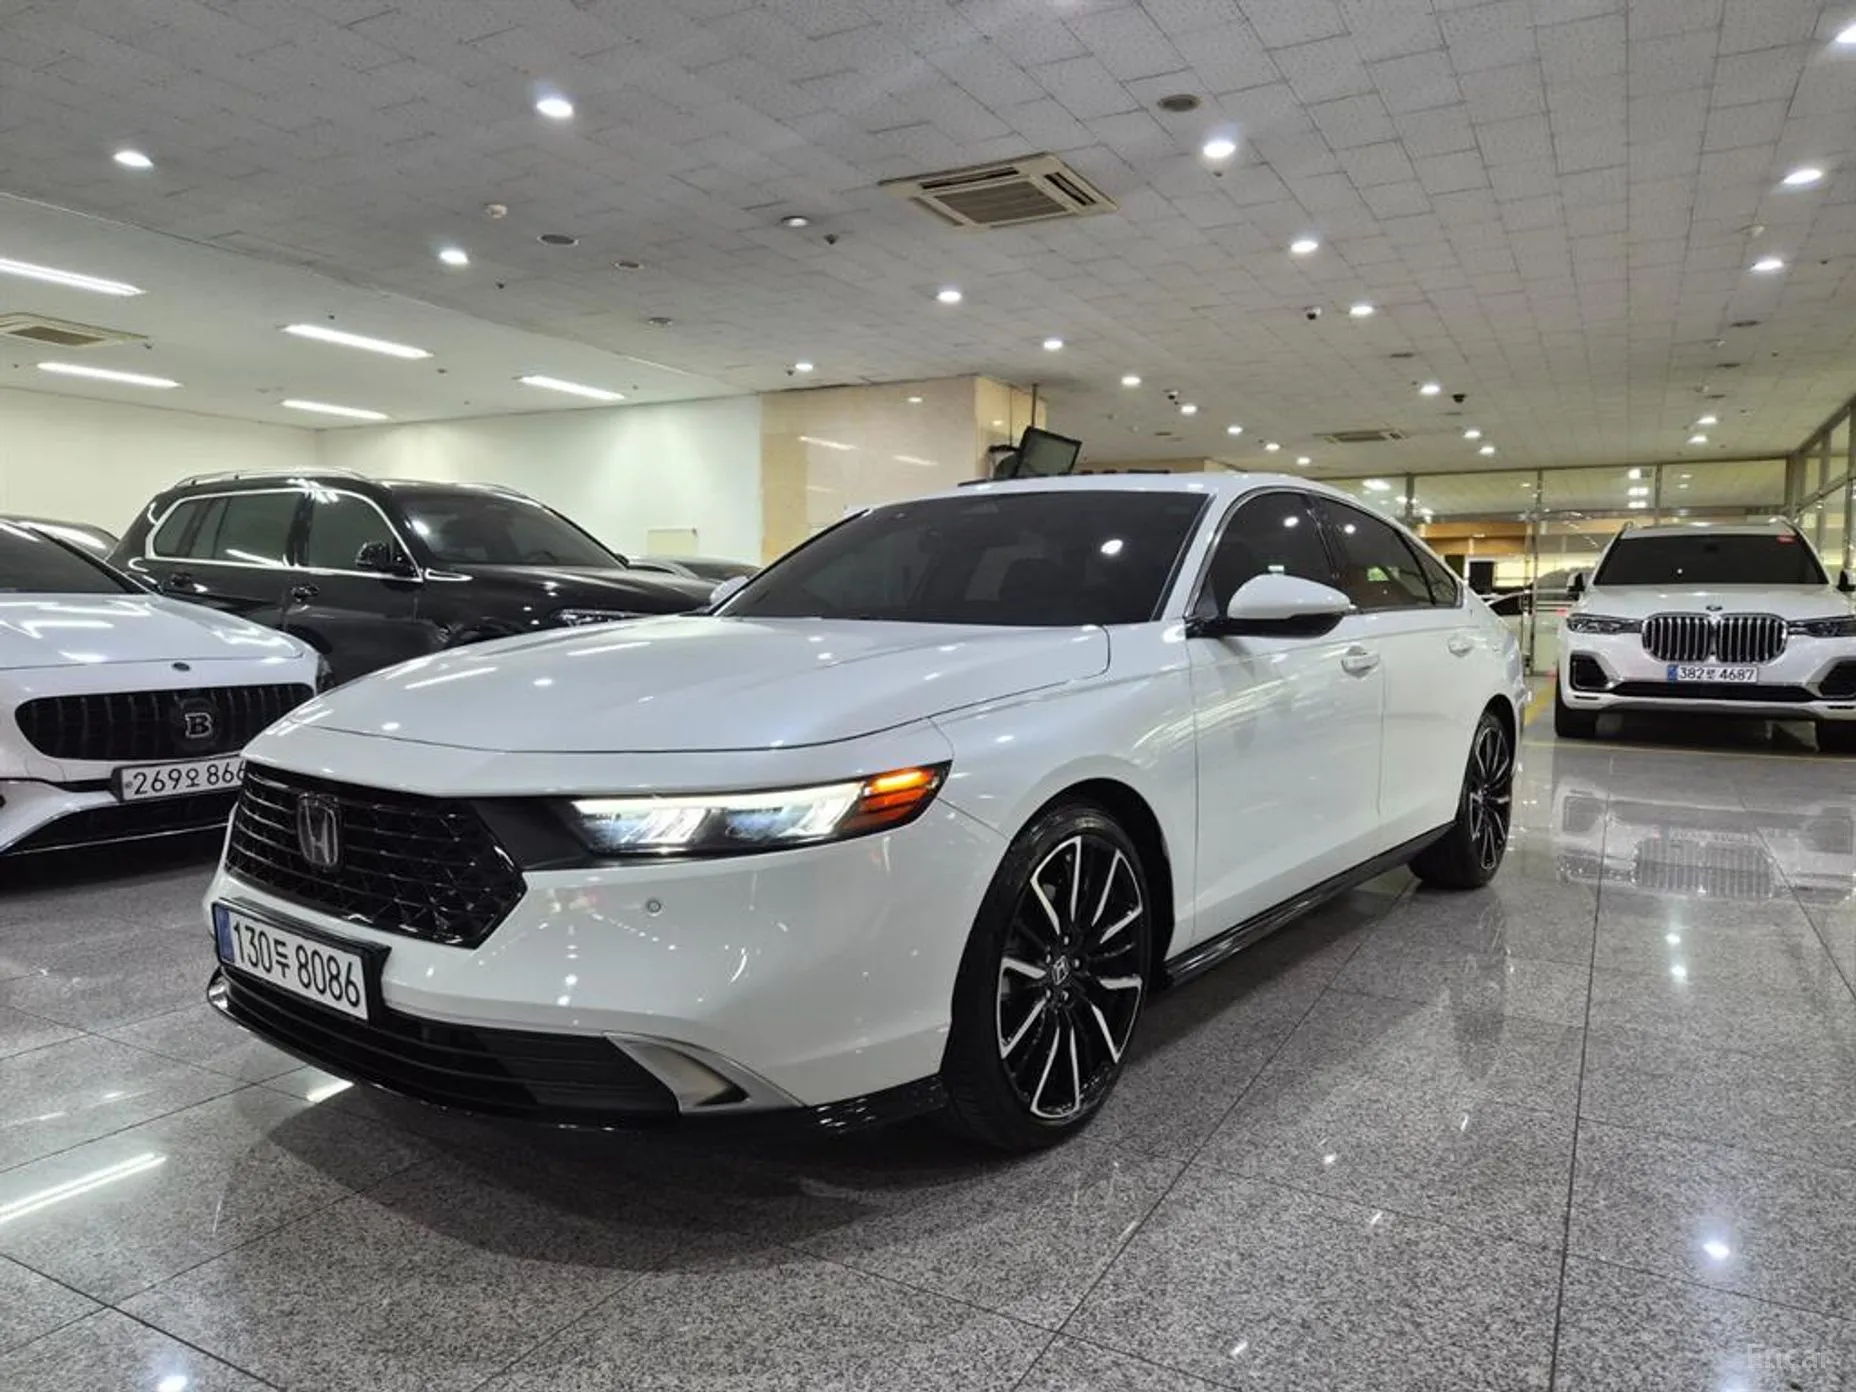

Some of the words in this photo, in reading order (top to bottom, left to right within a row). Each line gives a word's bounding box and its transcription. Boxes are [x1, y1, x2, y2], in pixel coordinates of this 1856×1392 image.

[1719, 668, 1755, 681] 4687
[185, 712, 213, 738] B
[133, 765, 200, 794] 269오
[234, 920, 290, 979] 130두
[295, 945, 360, 1008] 8086
